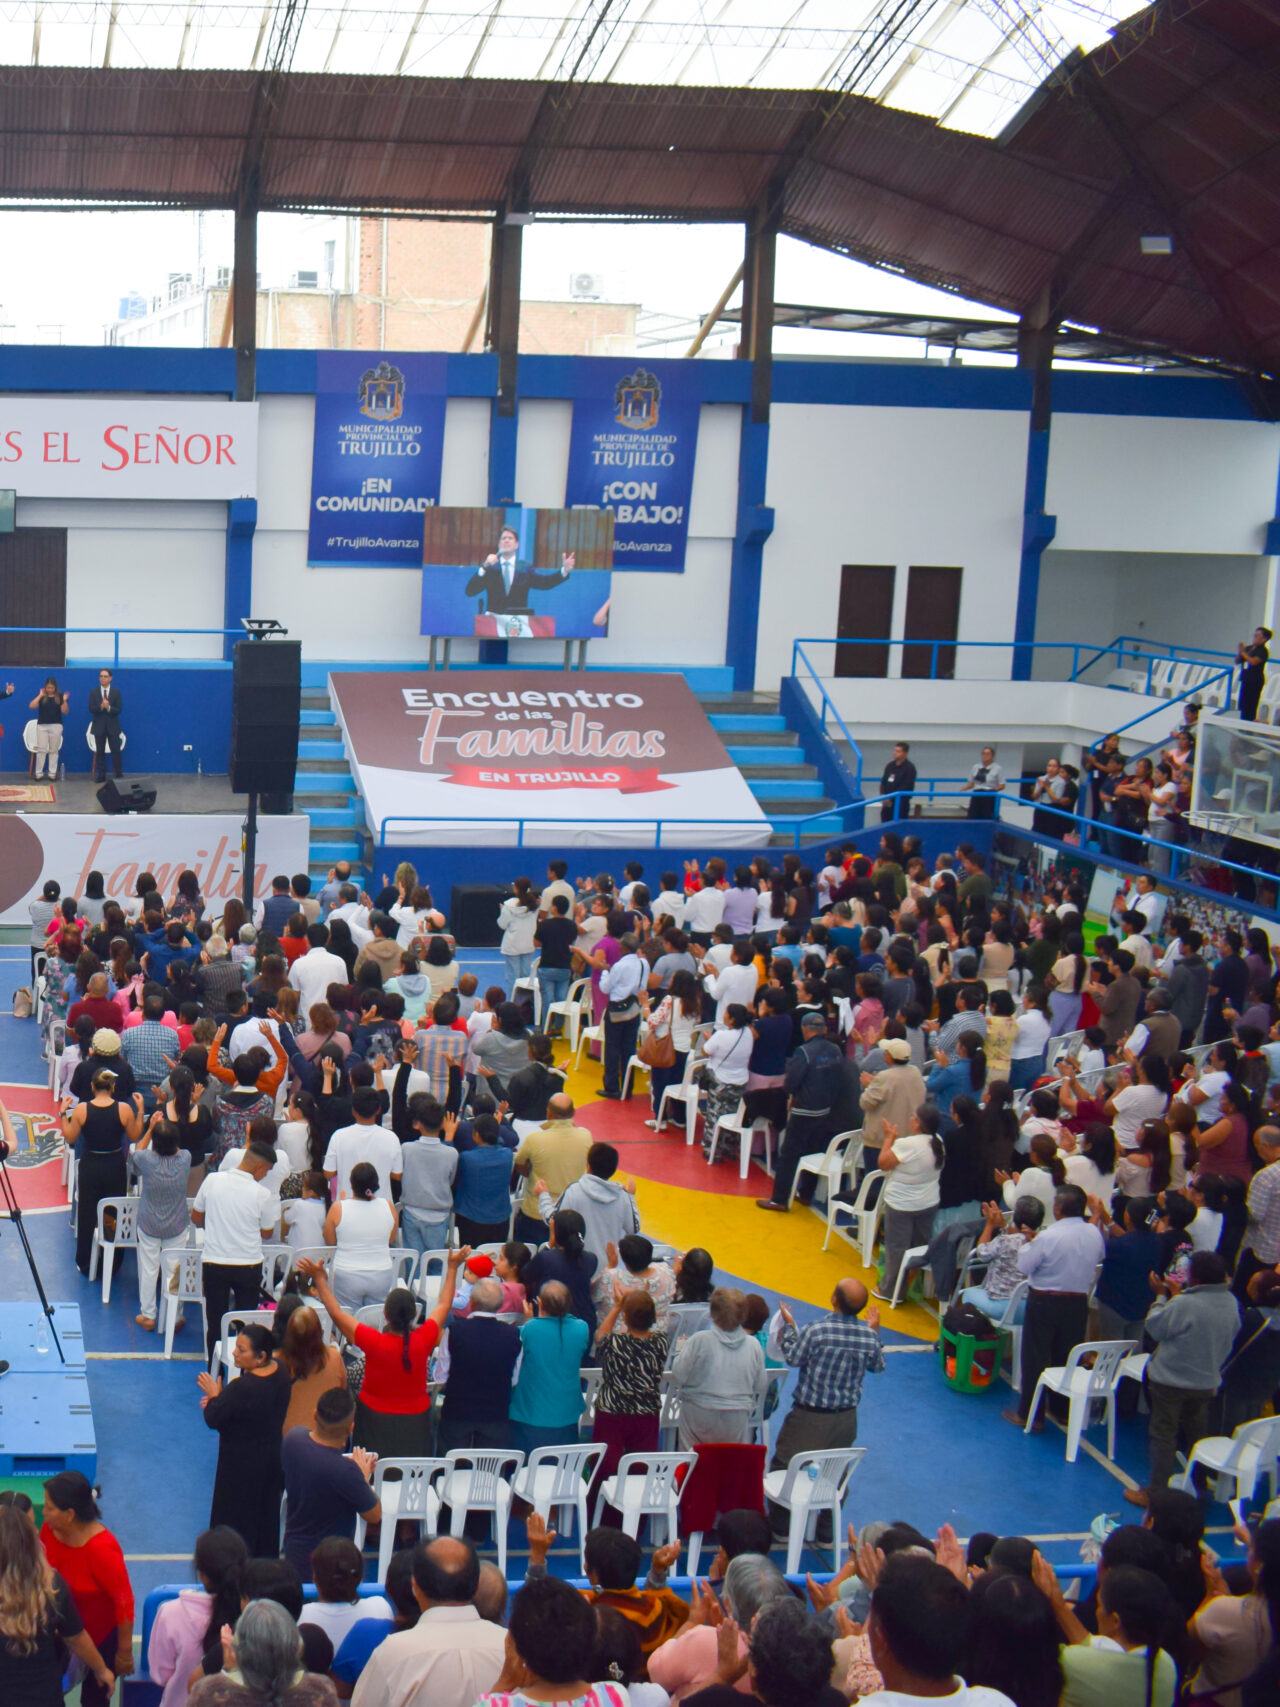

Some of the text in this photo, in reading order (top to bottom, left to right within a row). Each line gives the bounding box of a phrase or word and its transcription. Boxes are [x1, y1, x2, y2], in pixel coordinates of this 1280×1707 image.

[338, 425, 422, 434] MUNICIPALIDAD
[345, 433, 414, 441] PROVINCIAL DE
[593, 433, 677, 443] MUNICIPALIDAD
[43, 431, 80, 463] EL
[101, 425, 237, 471] SEÑOR
[338, 441, 421, 458] TRUJILLO
[599, 442, 669, 451] PROVINCIAL DE
[591, 450, 675, 469] TRUJILLO
[361, 478, 392, 496] ¡EN
[602, 481, 658, 503] ¡CON
[571, 504, 683, 524] BAJO!
[327, 537, 420, 549] #TrujilloAvanza
[402, 688, 644, 708] Encuentro
[494, 709, 553, 720] de las
[405, 707, 666, 765] Familias
[479, 772, 621, 783] EN TRUJILLO
